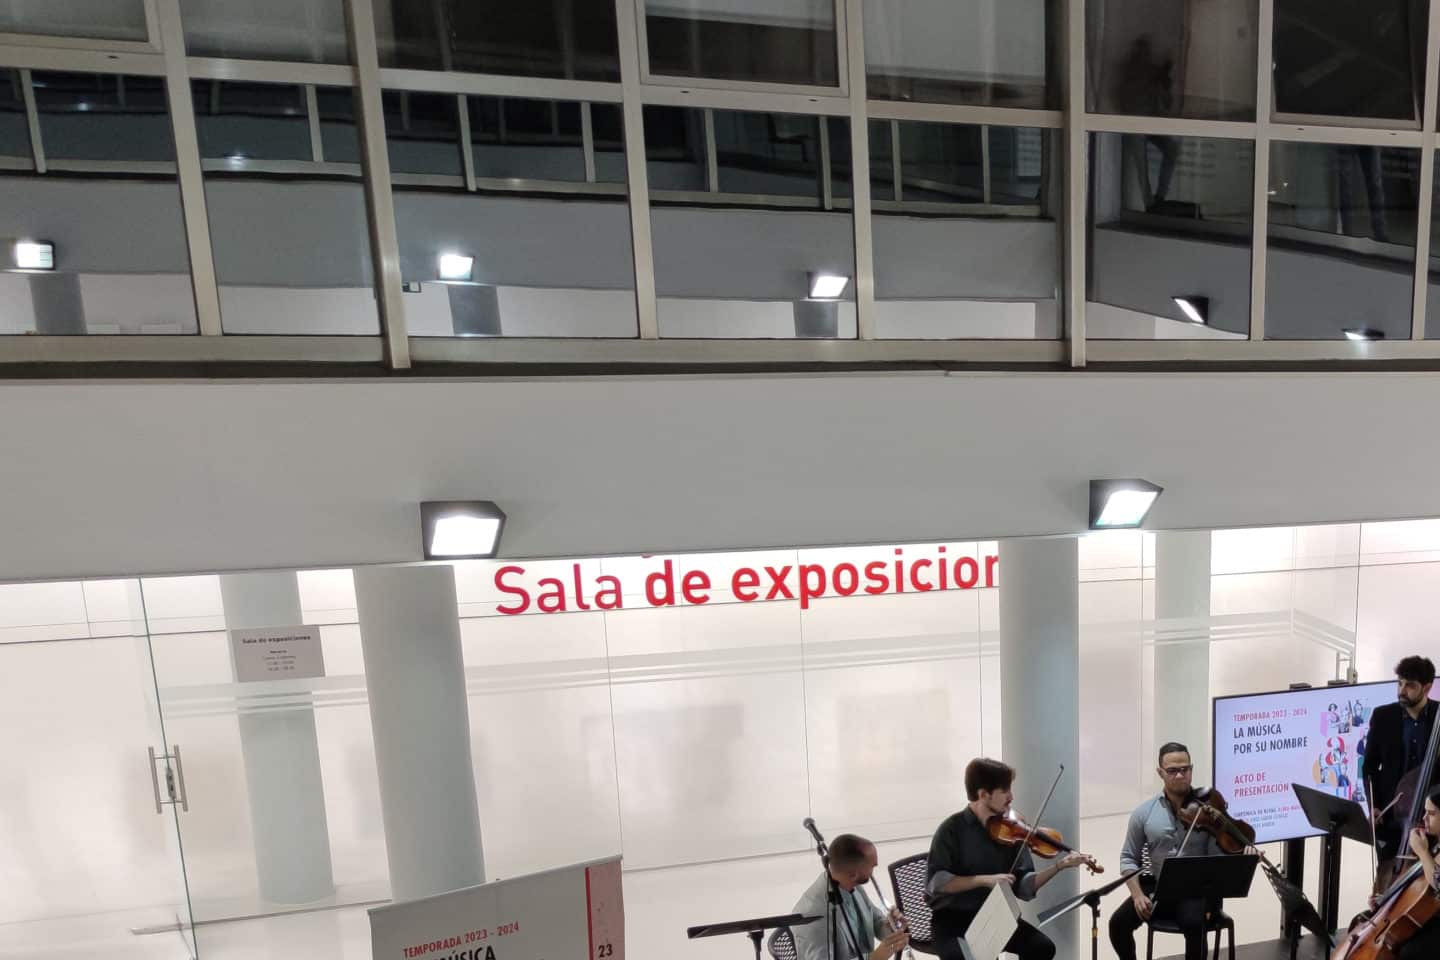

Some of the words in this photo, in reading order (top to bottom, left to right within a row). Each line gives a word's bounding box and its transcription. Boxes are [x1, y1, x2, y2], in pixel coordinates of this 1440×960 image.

[494, 563, 623, 615] Sala
[645, 559, 711, 607] de
[1233, 727, 1244, 739] LA
[1247, 722, 1282, 737] MÚSICA
[1233, 742, 1252, 755] POR
[1255, 740, 1267, 753] SU
[1270, 736, 1308, 751] NOMBRE
[1234, 773, 1254, 785] ACTO
[1256, 772, 1265, 782] DE
[403, 935, 462, 959] TEMPORADA
[464, 928, 488, 944] 2023
[497, 921, 520, 937] 2024
[598, 943, 613, 958] 23
